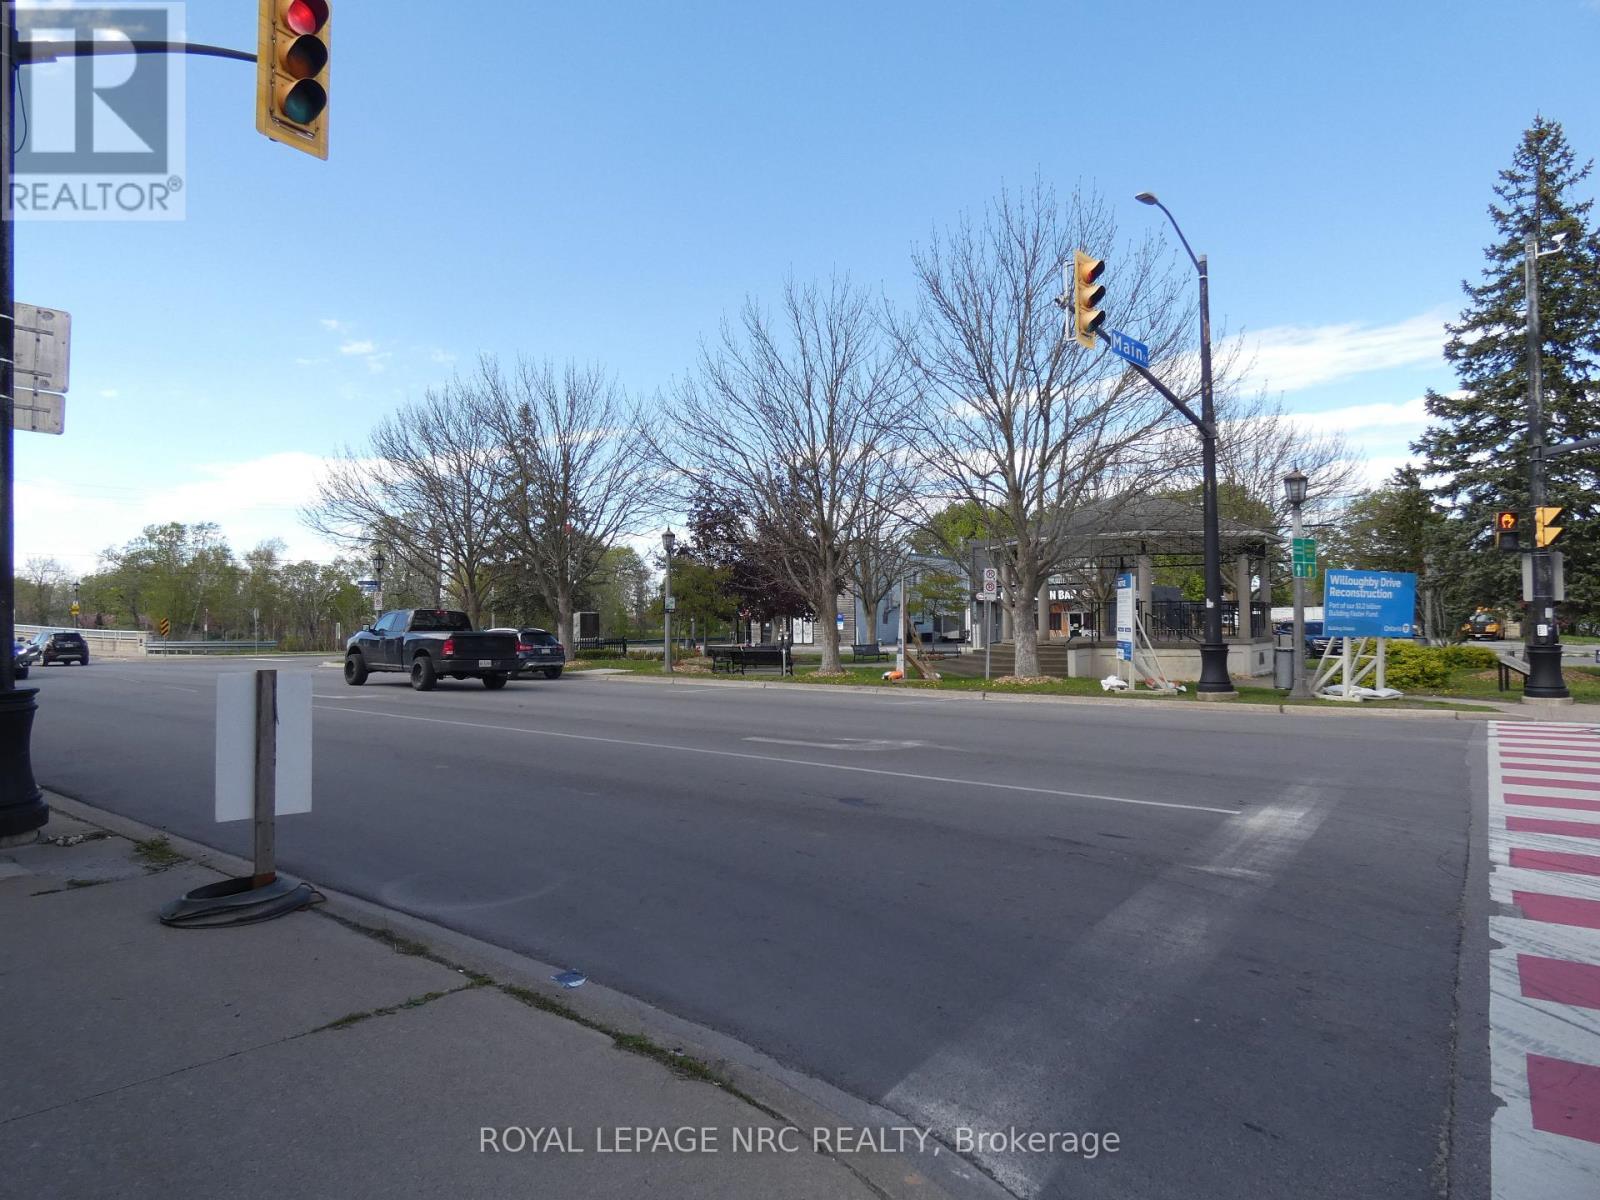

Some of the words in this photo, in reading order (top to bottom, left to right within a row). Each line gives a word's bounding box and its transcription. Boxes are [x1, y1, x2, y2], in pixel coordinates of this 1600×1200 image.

[1113, 333, 1142, 361] Main
[1330, 575, 1379, 589] Willoughby
[1380, 578, 1401, 588] Drive
[1329, 587, 1393, 599] Reconstruction
